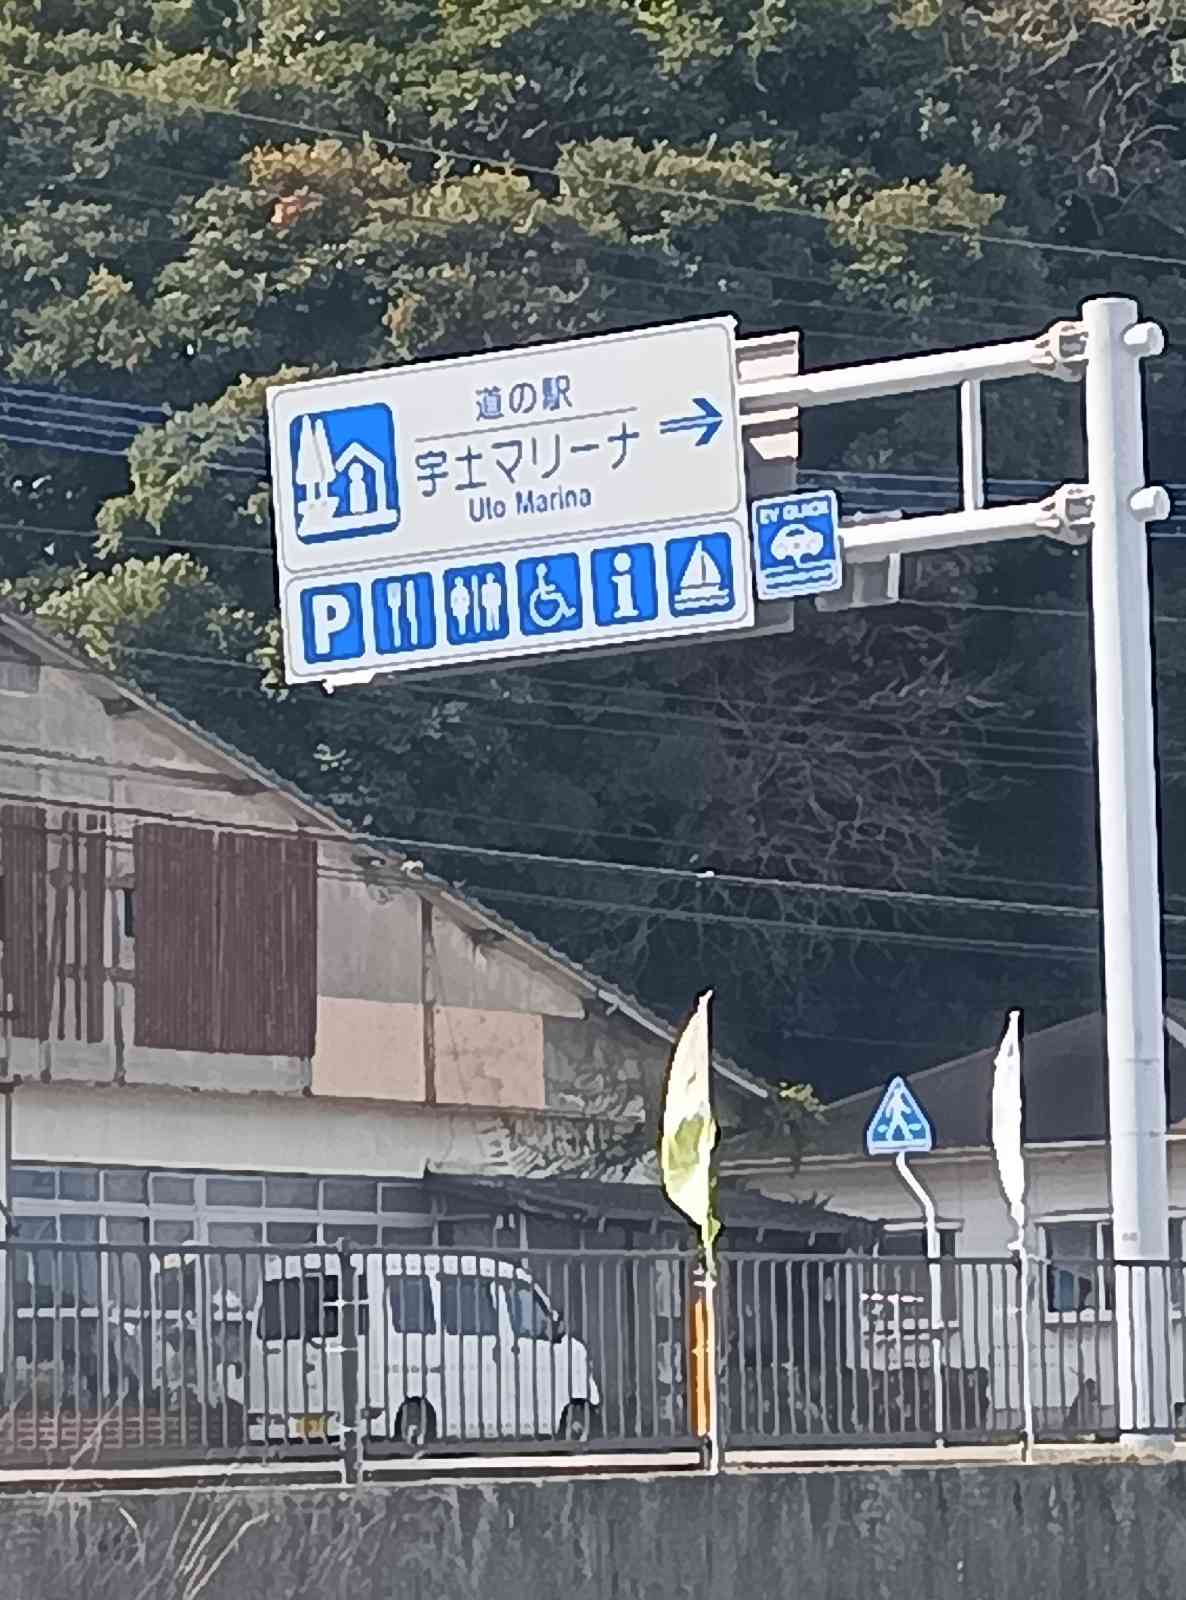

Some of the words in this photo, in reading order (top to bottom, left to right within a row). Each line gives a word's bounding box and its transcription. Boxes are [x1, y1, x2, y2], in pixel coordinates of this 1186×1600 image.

[476, 375, 572, 421] 道の駅
[415, 422, 639, 497] 宇土マリーナ
[515, 486, 592, 514] Marina
[312, 594, 350, 654] P
